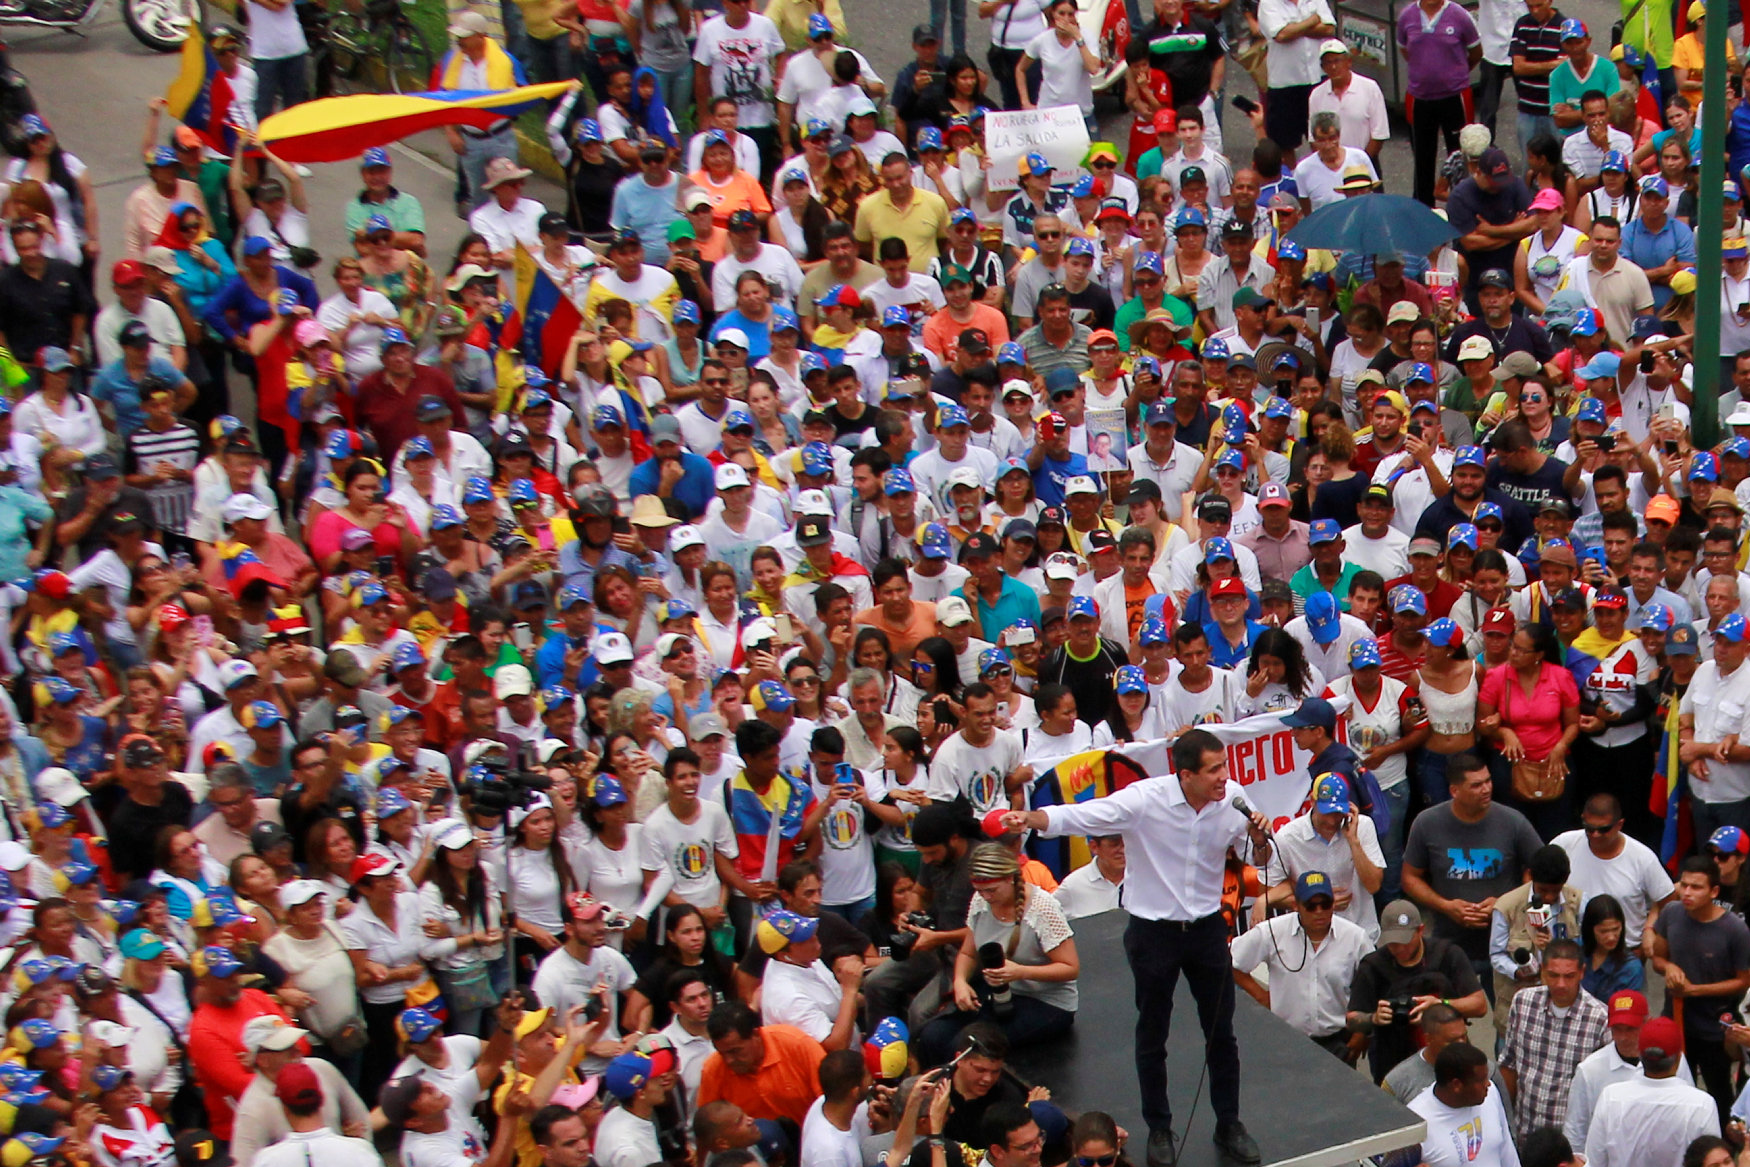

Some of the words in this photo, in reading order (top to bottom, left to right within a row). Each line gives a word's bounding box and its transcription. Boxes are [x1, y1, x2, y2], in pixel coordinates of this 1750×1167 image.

[994, 134, 1011, 149] LA
[1017, 131, 1058, 147] SALIDA
[1155, 404, 1167, 414] T
[1498, 482, 1550, 503] SEATTLE
